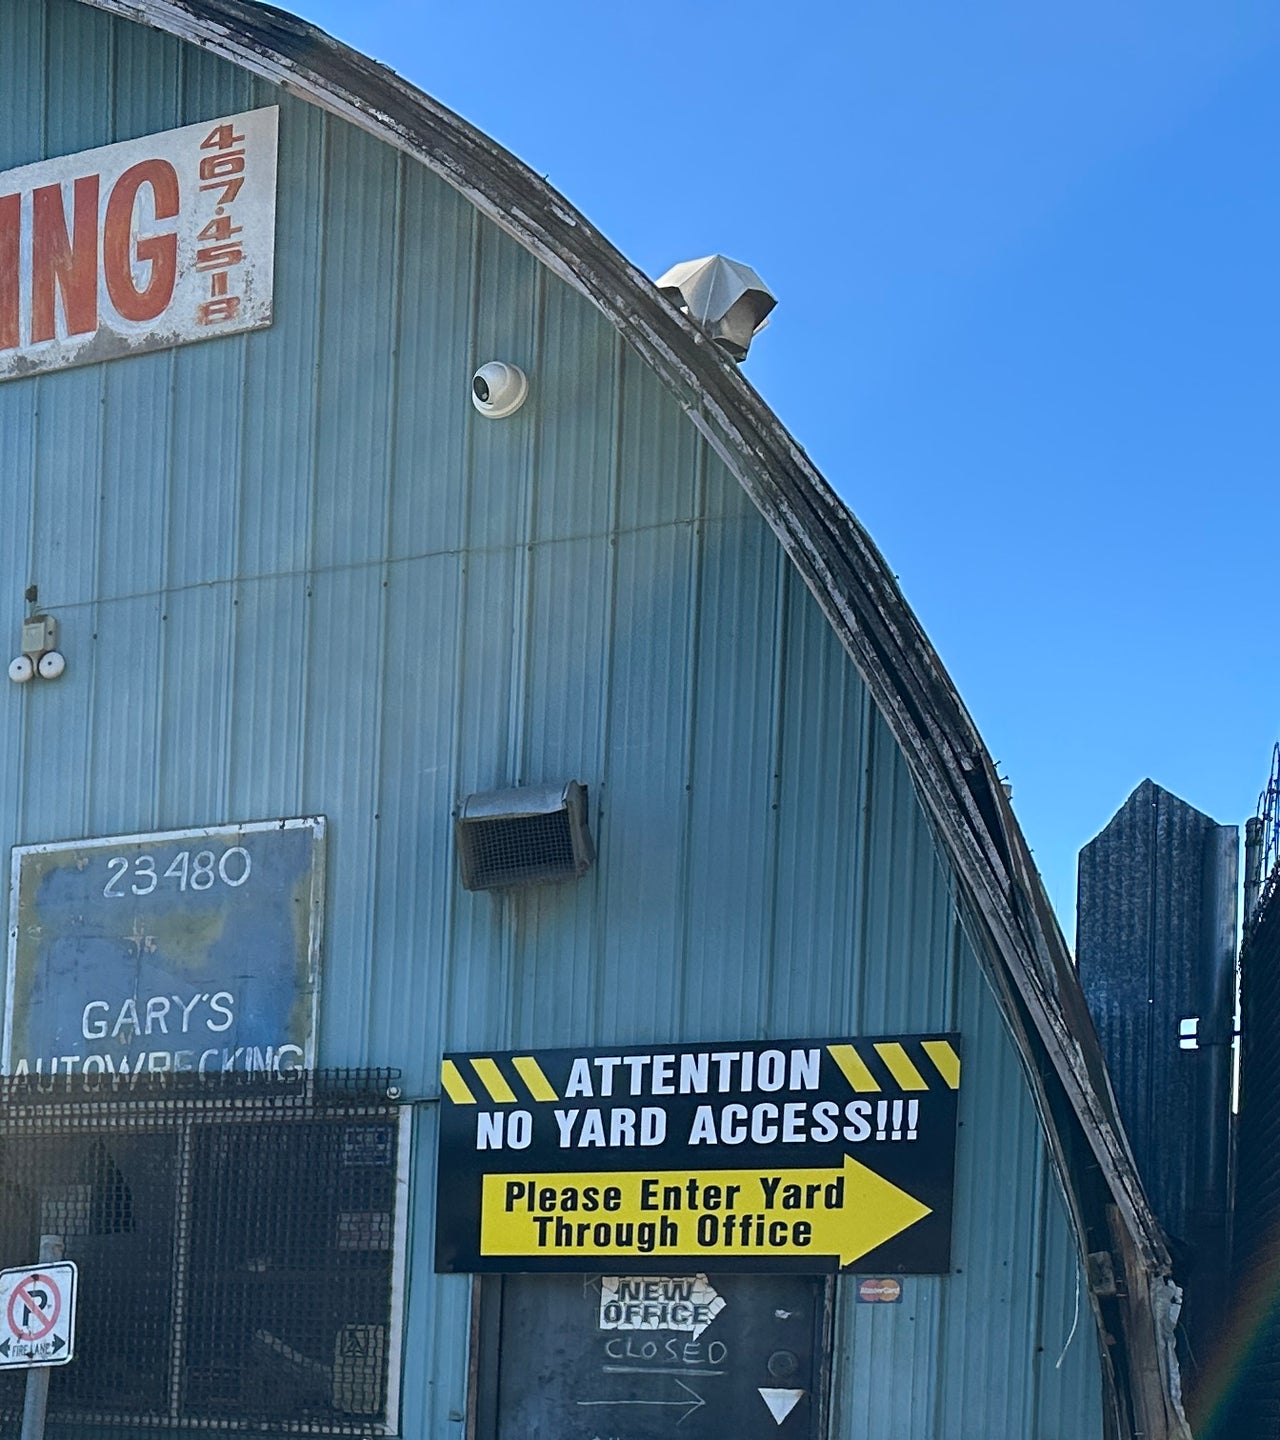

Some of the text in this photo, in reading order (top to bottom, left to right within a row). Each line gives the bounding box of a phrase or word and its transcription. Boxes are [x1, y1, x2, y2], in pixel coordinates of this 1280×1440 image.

[102, 846, 253, 899] 23480
[81, 991, 235, 1040] GARY'S
[564, 1048, 822, 1099] ATTENTION
[475, 1099, 920, 1151] NO YARD ACCESS!!!
[504, 1176, 845, 1212] Please Enter Yard
[532, 1213, 813, 1253] Through Office
[619, 1281, 693, 1301] NEW
[603, 1301, 710, 1325] OFFICE
[604, 1337, 728, 1365] CLOSED
